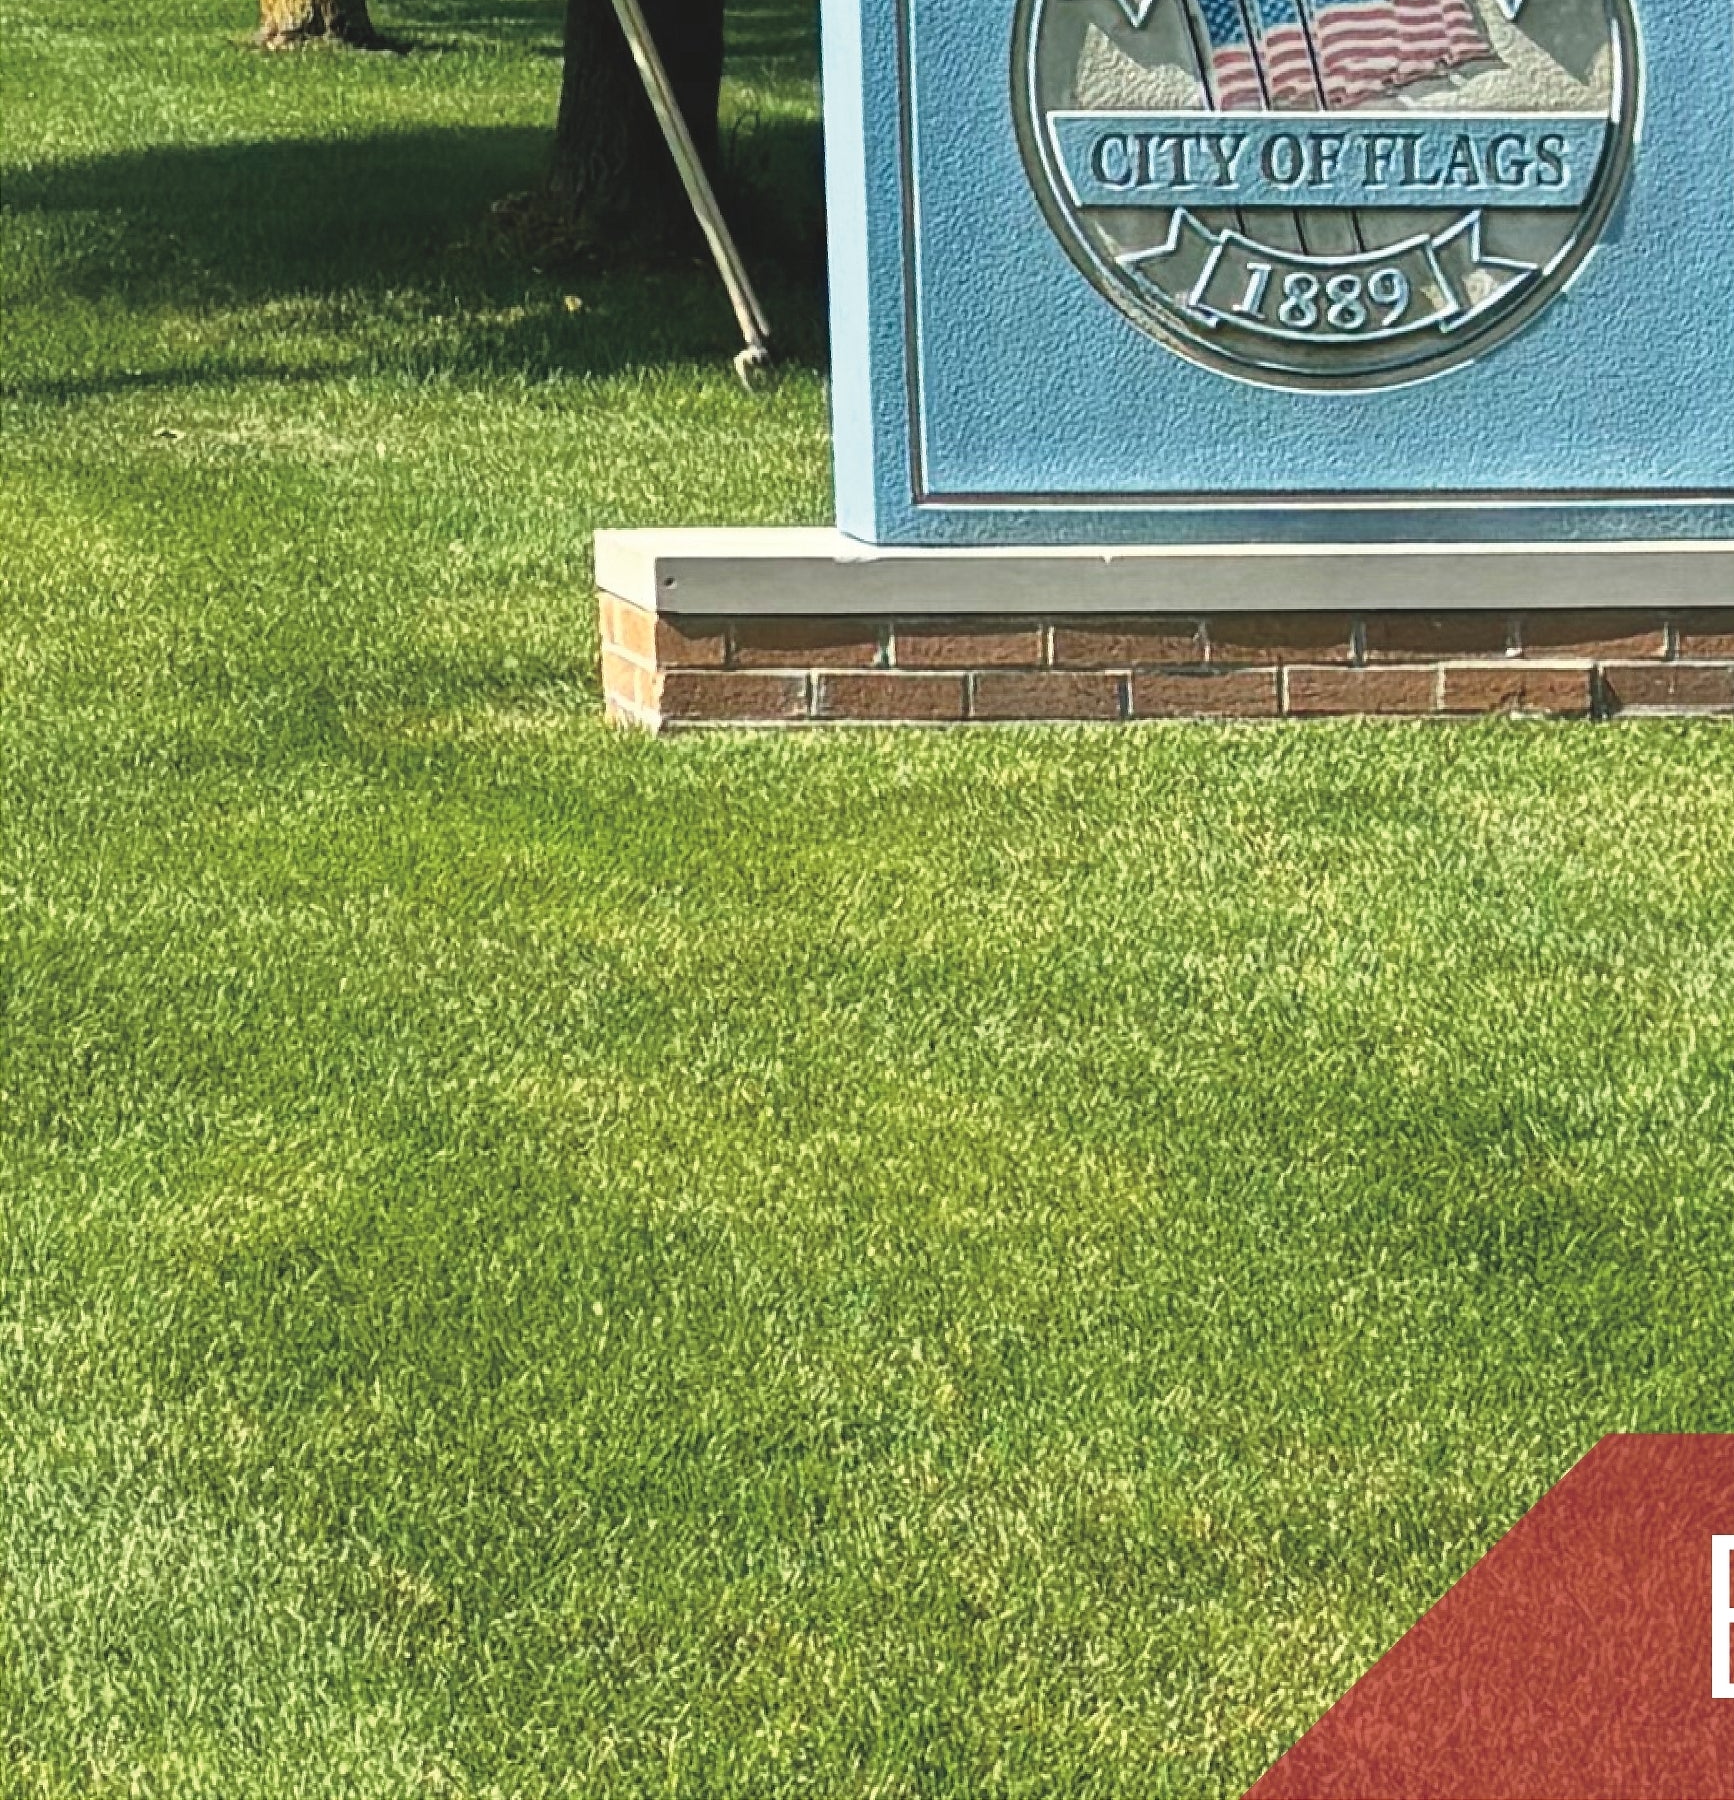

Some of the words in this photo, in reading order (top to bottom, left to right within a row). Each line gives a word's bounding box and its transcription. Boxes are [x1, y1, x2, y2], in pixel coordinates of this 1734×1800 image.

[1090, 132, 1248, 190] CITY
[1261, 132, 1347, 190] OF
[1361, 132, 1572, 191] FLAGS
[1231, 262, 1413, 330] 1889
